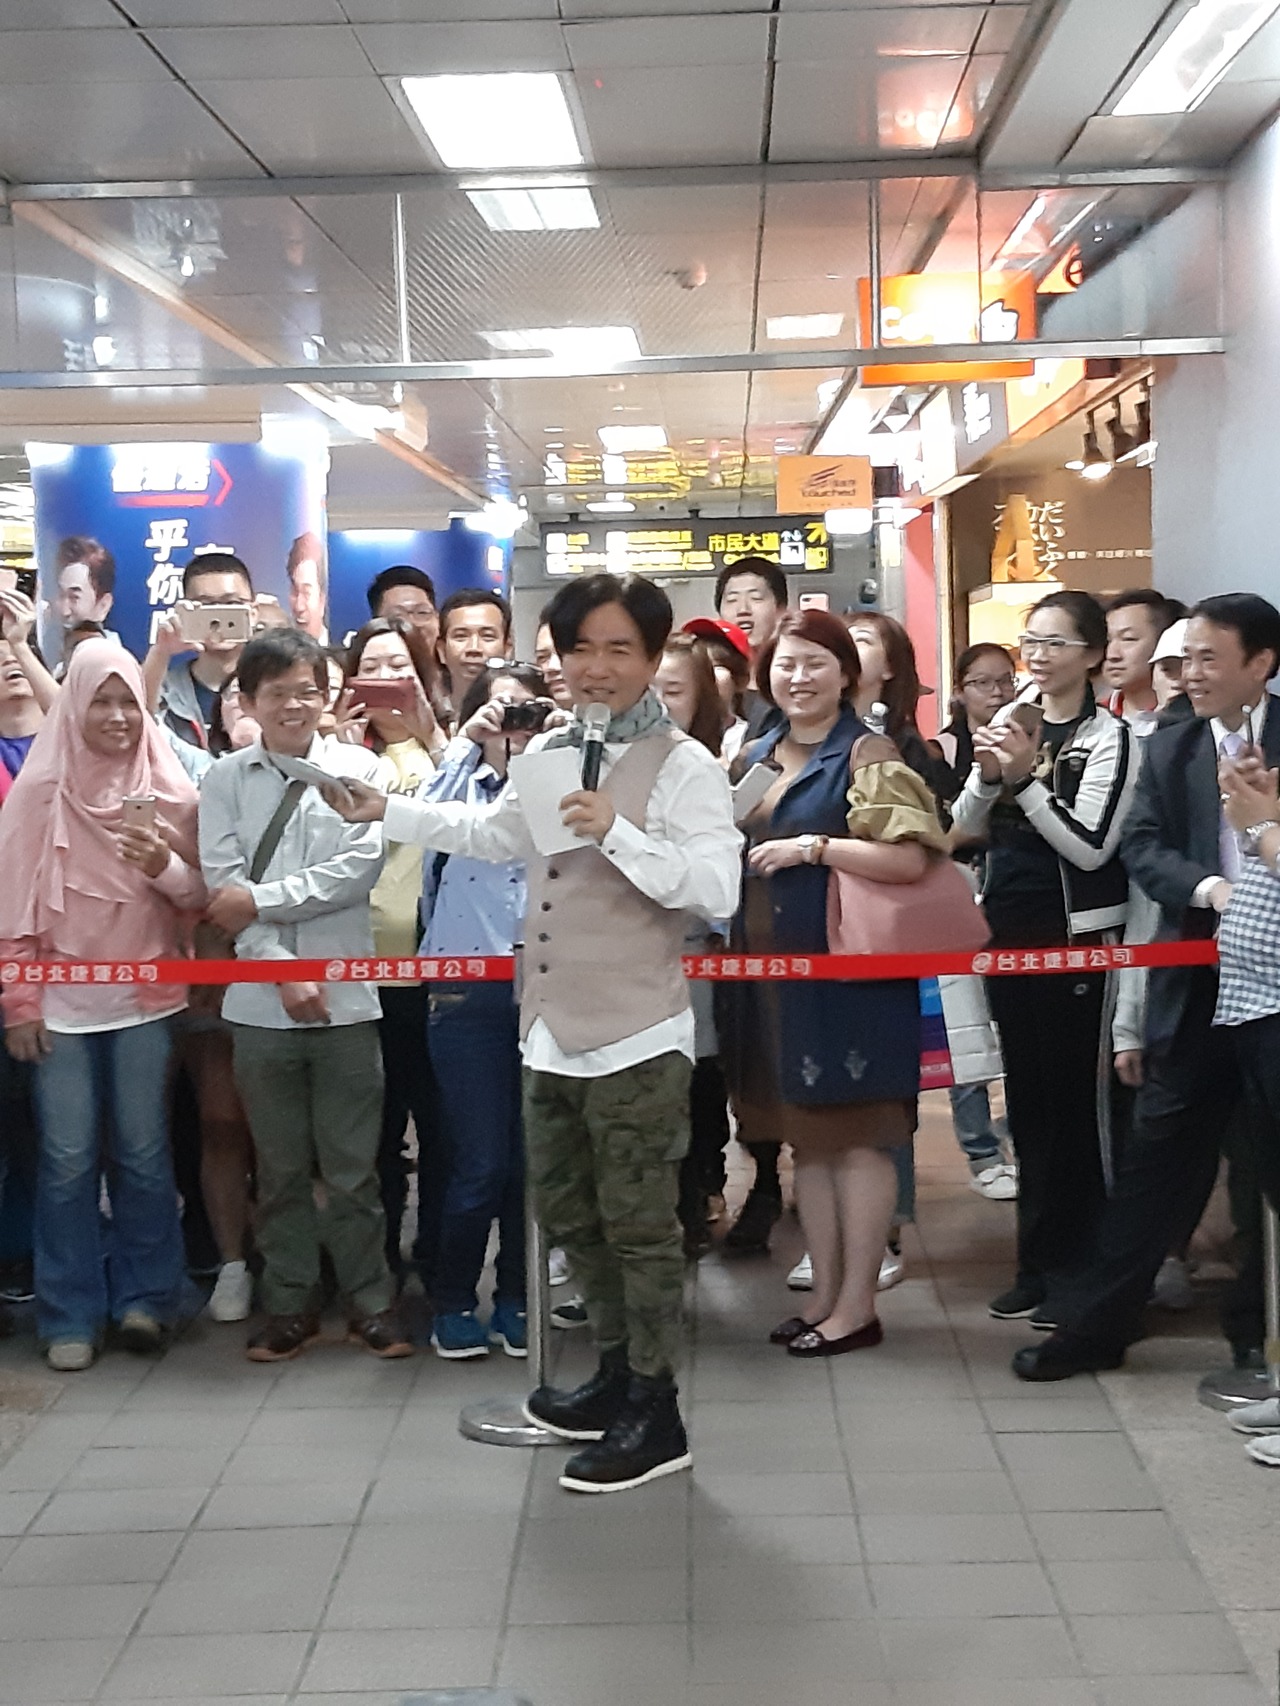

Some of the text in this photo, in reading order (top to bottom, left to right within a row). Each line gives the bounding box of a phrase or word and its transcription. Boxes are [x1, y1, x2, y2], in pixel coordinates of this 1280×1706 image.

[707, 531, 780, 553] 市民大道
[1037, 500, 1067, 583] だいふく
[350, 959, 486, 979] 台北捷運公司
[998, 948, 1133, 972] 台北捷運公司
[24, 964, 158, 982] 台北捷運公司
